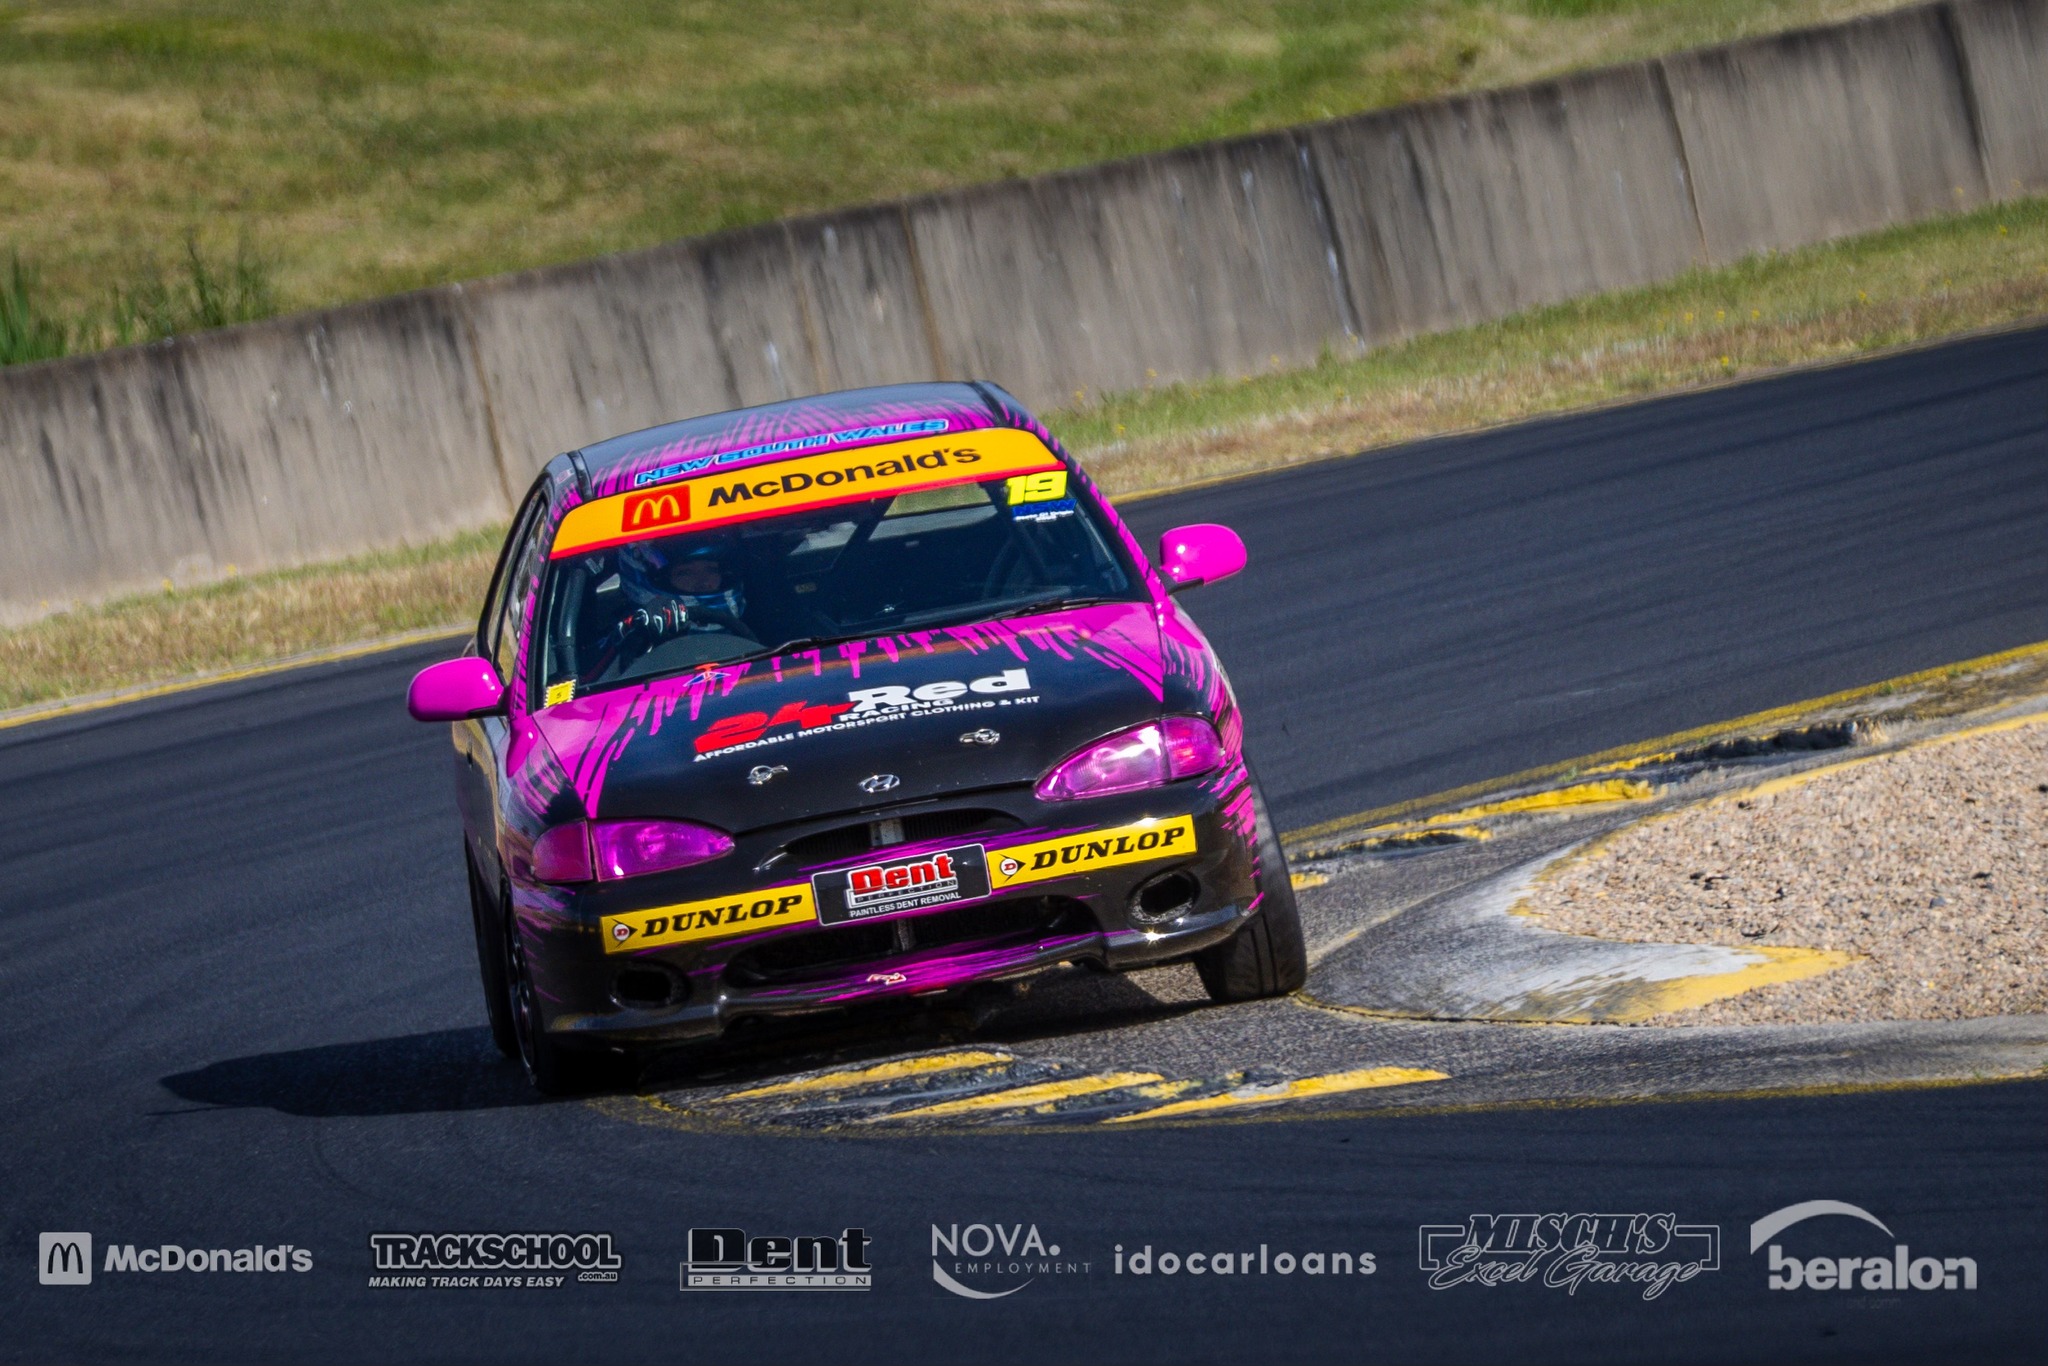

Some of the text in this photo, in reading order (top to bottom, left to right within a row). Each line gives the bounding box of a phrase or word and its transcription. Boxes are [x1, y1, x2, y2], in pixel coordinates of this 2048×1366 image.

[637, 420, 949, 484] NEW SOUTH WALES
[708, 447, 981, 507] McDonald's
[1006, 470, 1068, 505] 19
[693, 695, 1041, 763] AFFORDABLE MOTORSPORT CLOTHING & KIT
[839, 698, 955, 722] RACING
[1030, 826, 1187, 871] DUNLOP
[849, 854, 956, 895] Dent
[856, 880, 956, 902] PERFECTION
[642, 893, 804, 937] DUNLOP
[850, 892, 961, 919] PAINTLESS DENT REMOVAL
